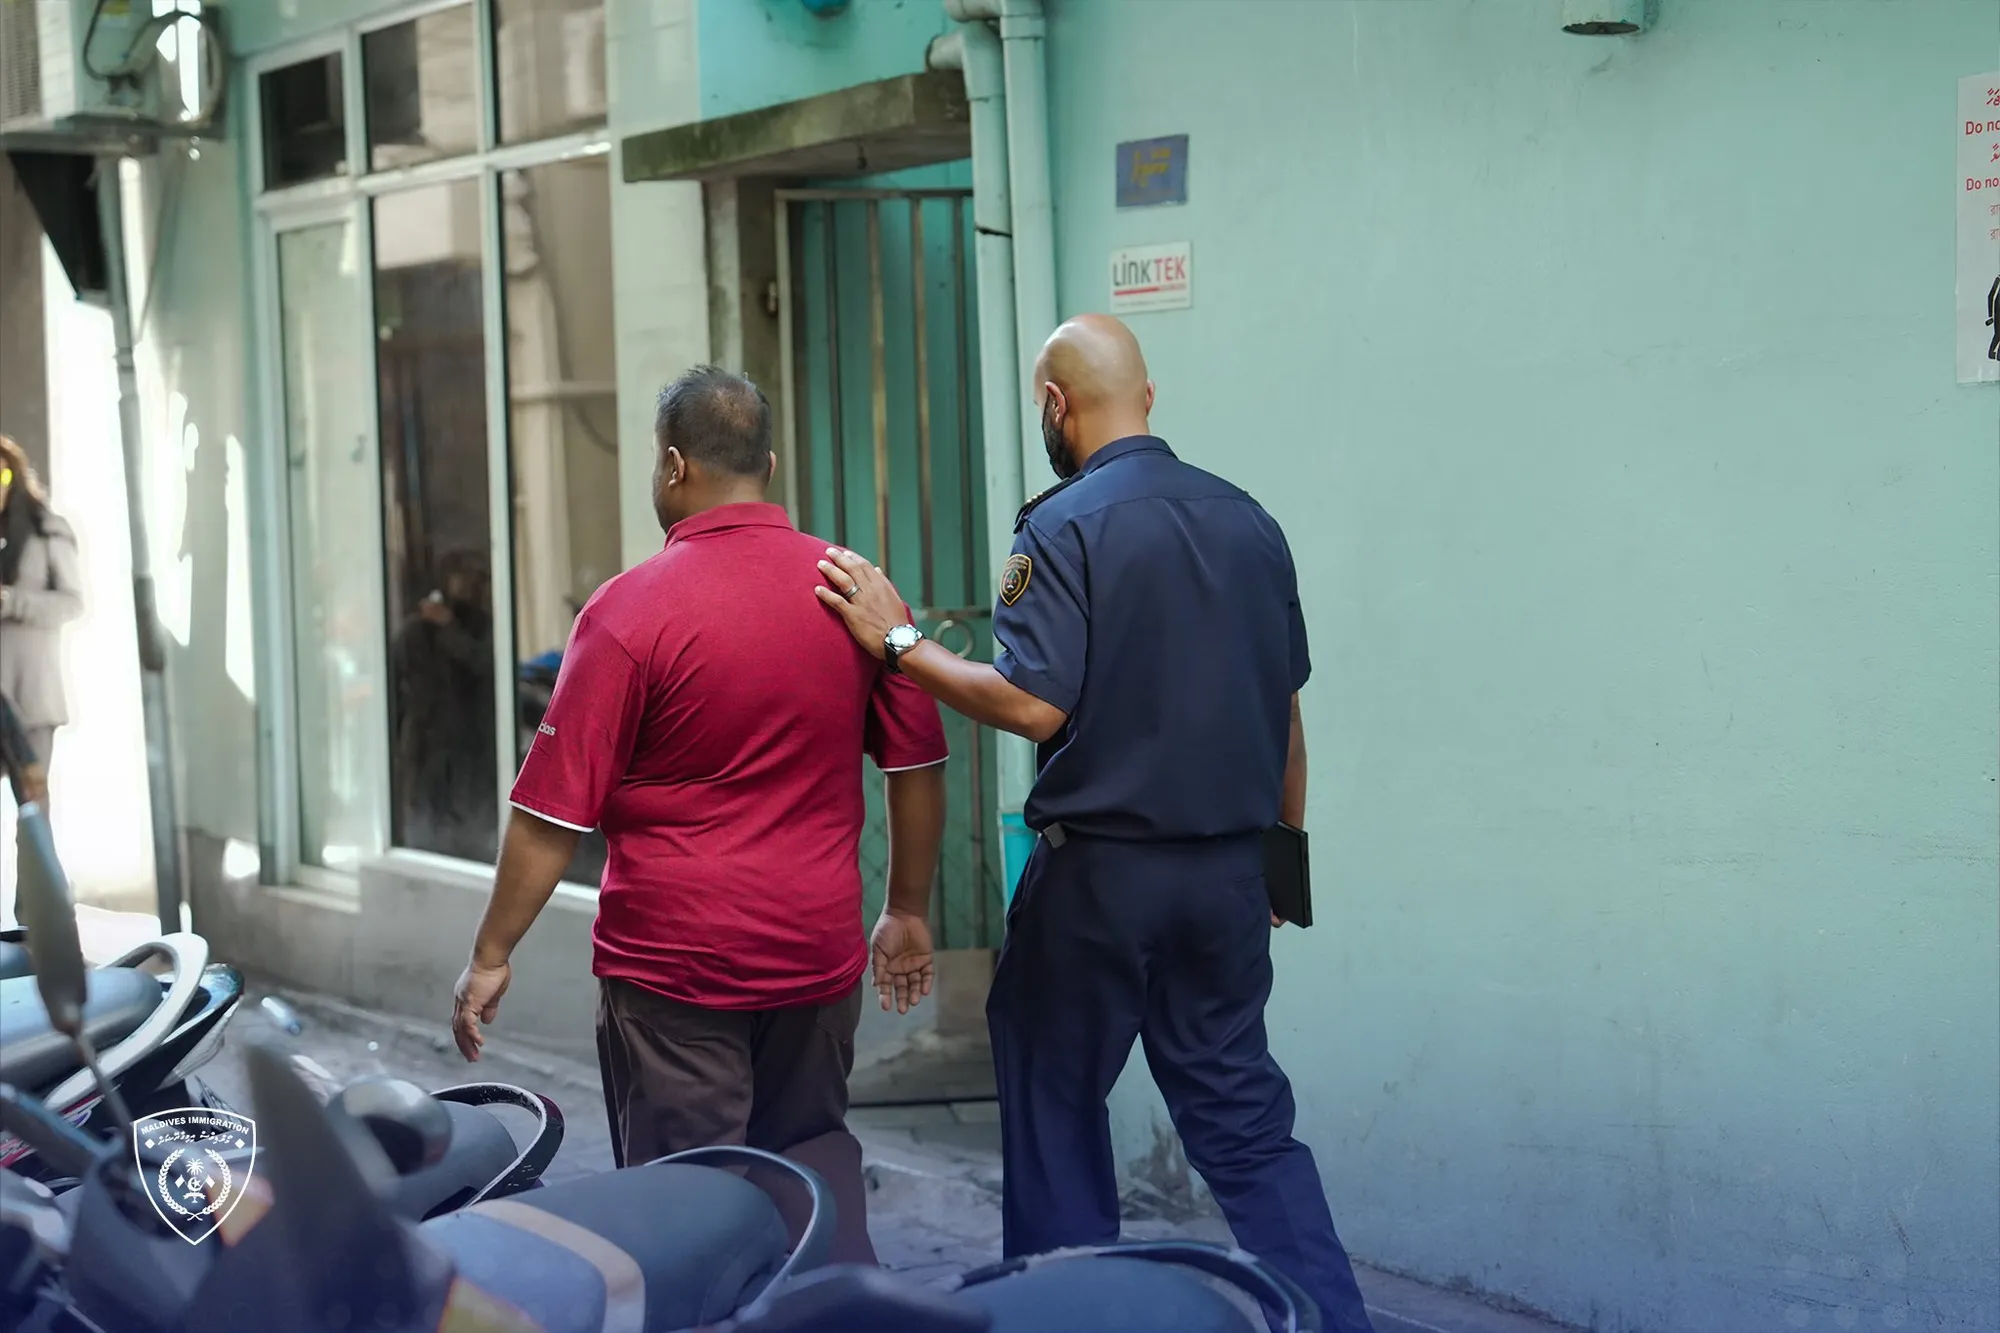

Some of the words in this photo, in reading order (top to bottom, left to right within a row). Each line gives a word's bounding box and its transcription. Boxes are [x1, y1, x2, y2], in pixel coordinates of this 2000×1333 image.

[1966, 121, 1982, 135] Do
[1966, 178, 1981, 191] Do
[1985, 177, 2000, 188] no
